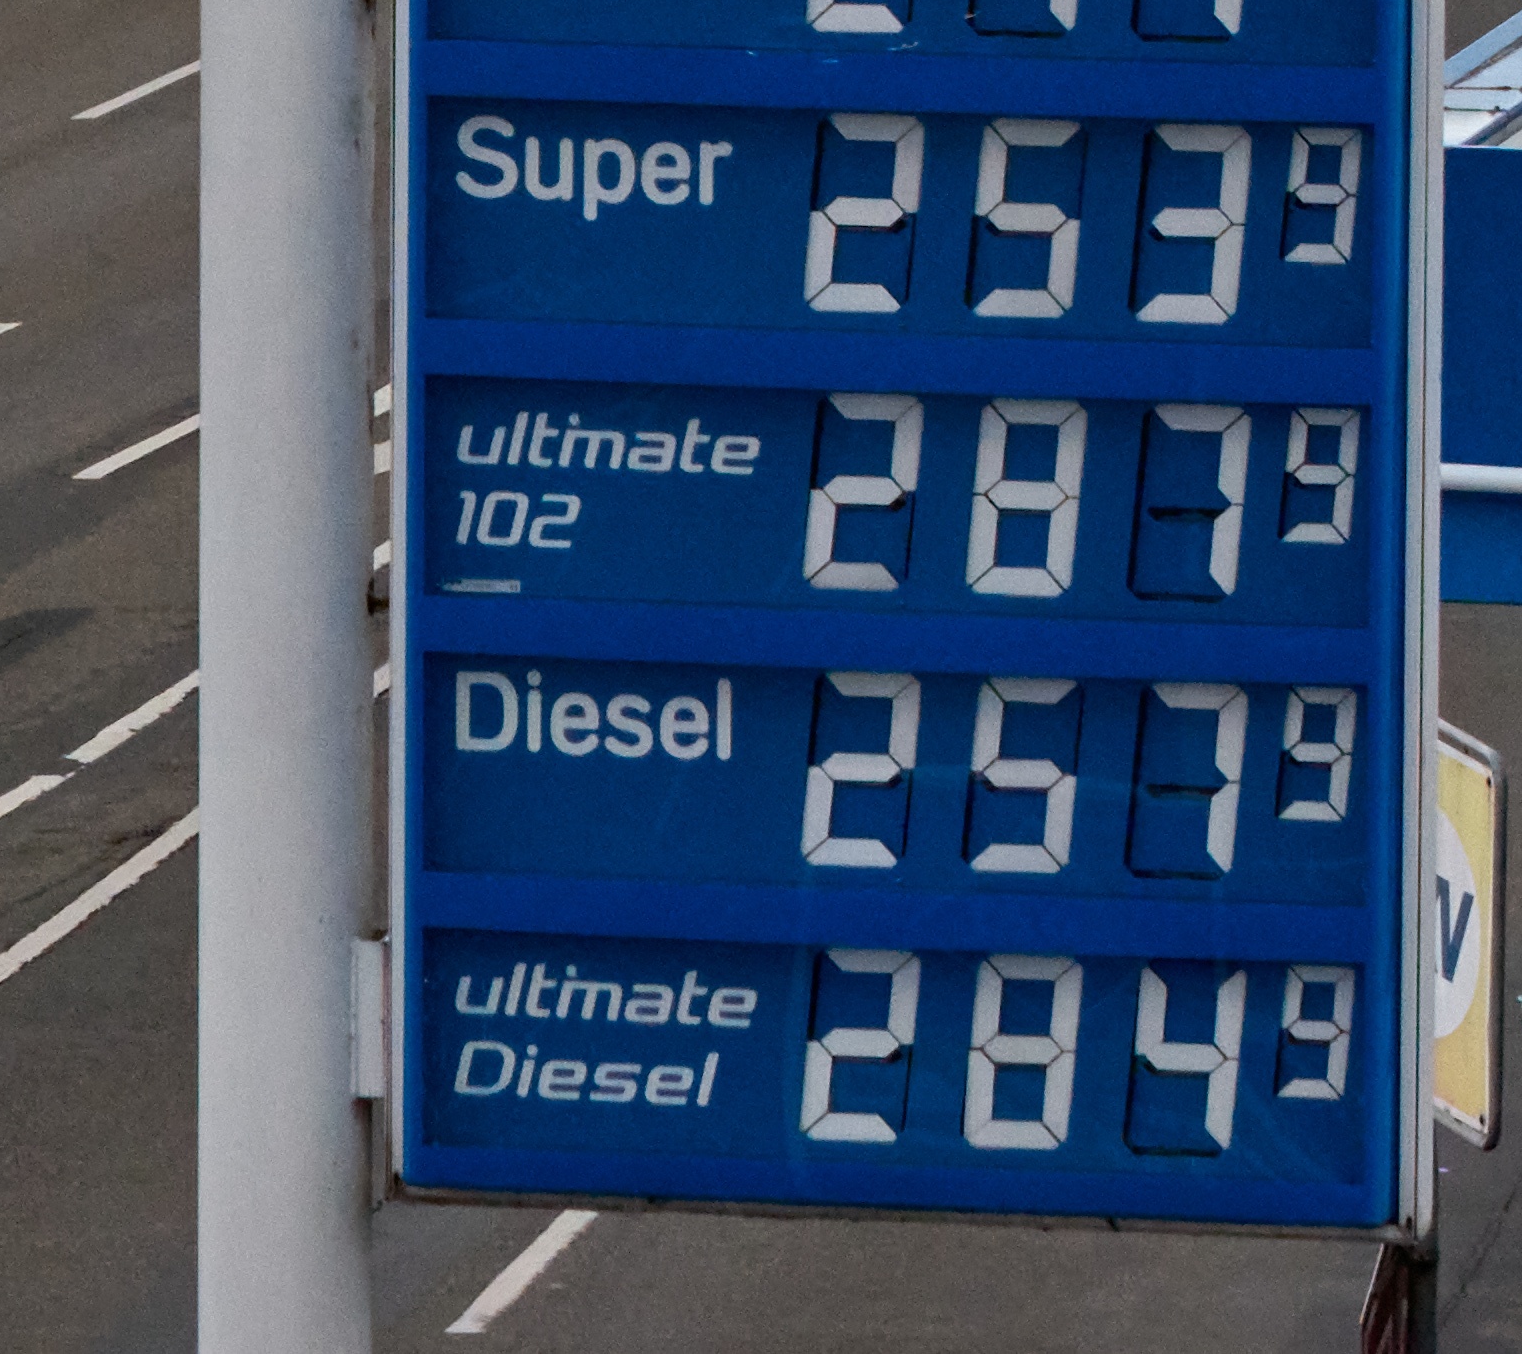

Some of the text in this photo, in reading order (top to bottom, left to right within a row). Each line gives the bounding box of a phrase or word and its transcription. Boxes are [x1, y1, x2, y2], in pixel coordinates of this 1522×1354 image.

[455, 115, 733, 221] Super
[457, 411, 762, 475] ultimate
[456, 490, 582, 549] 102
[455, 670, 732, 761] Diesel
[455, 962, 758, 1029] ultimate
[454, 1040, 720, 1108] Diesel
